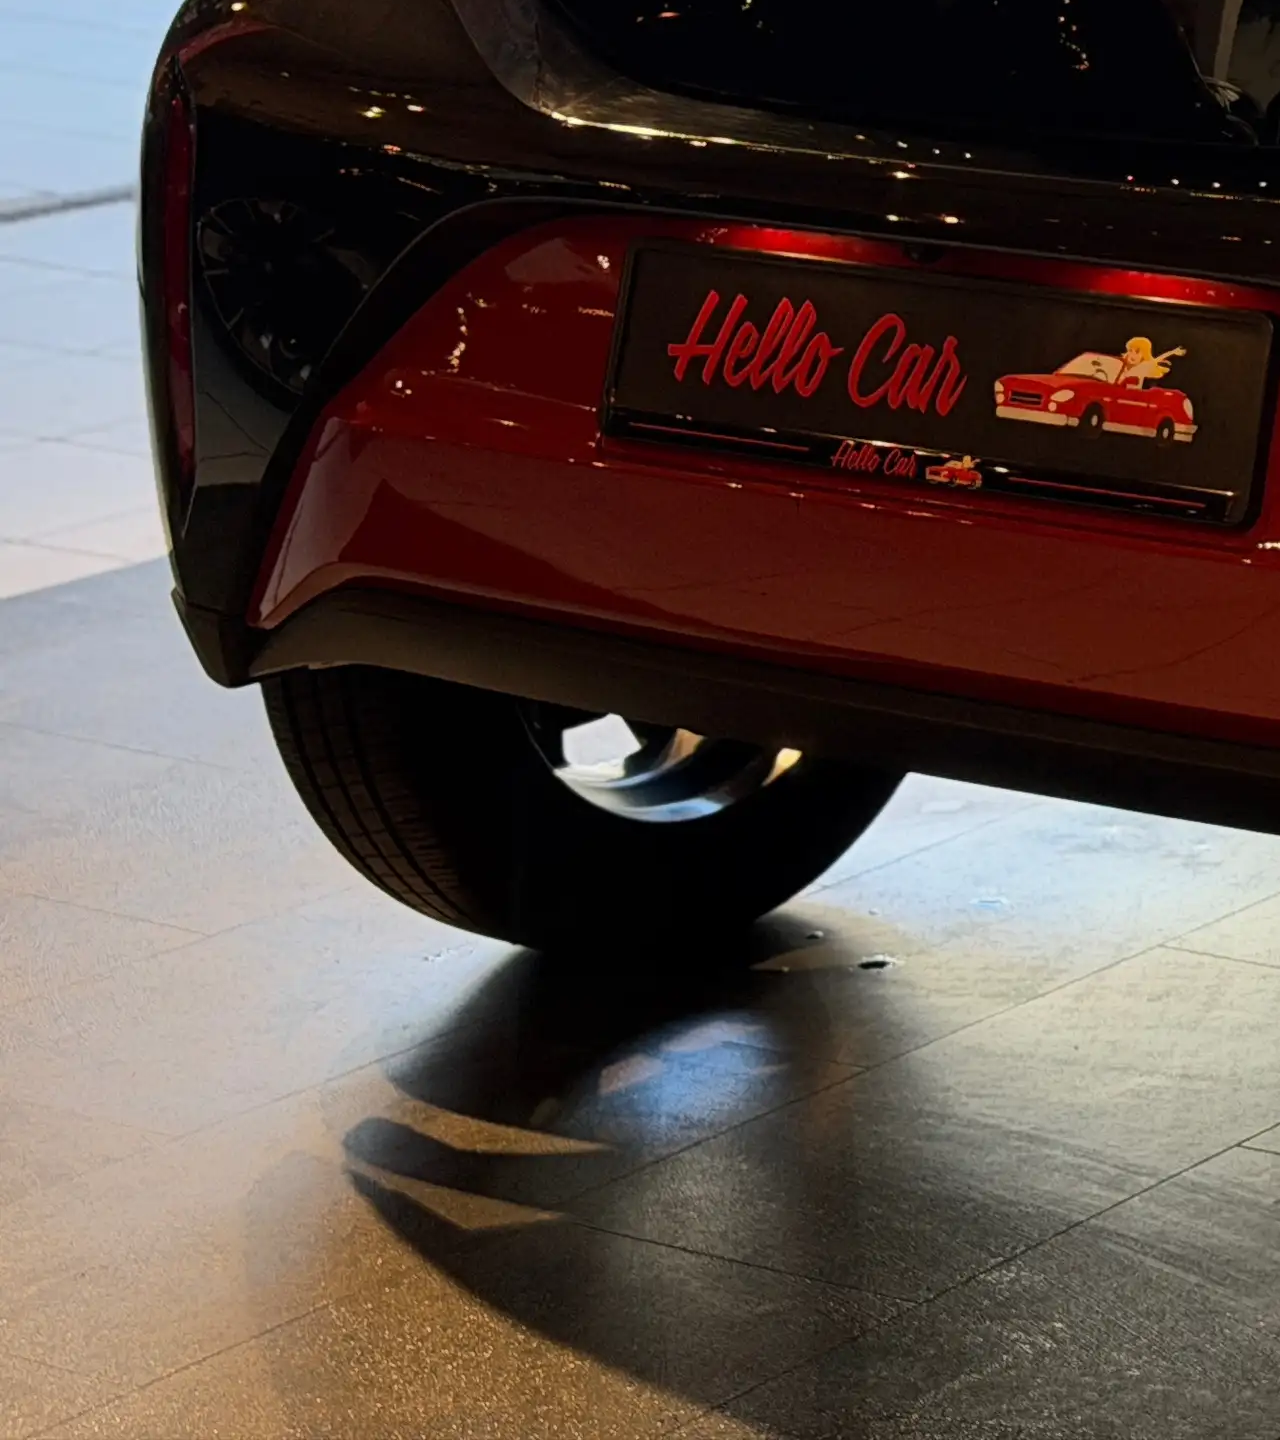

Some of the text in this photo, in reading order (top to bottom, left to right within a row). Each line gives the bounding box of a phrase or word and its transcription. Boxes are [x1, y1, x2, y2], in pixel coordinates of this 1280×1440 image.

[667, 289, 968, 417] Hello Car
[831, 439, 918, 479] Hello Car
